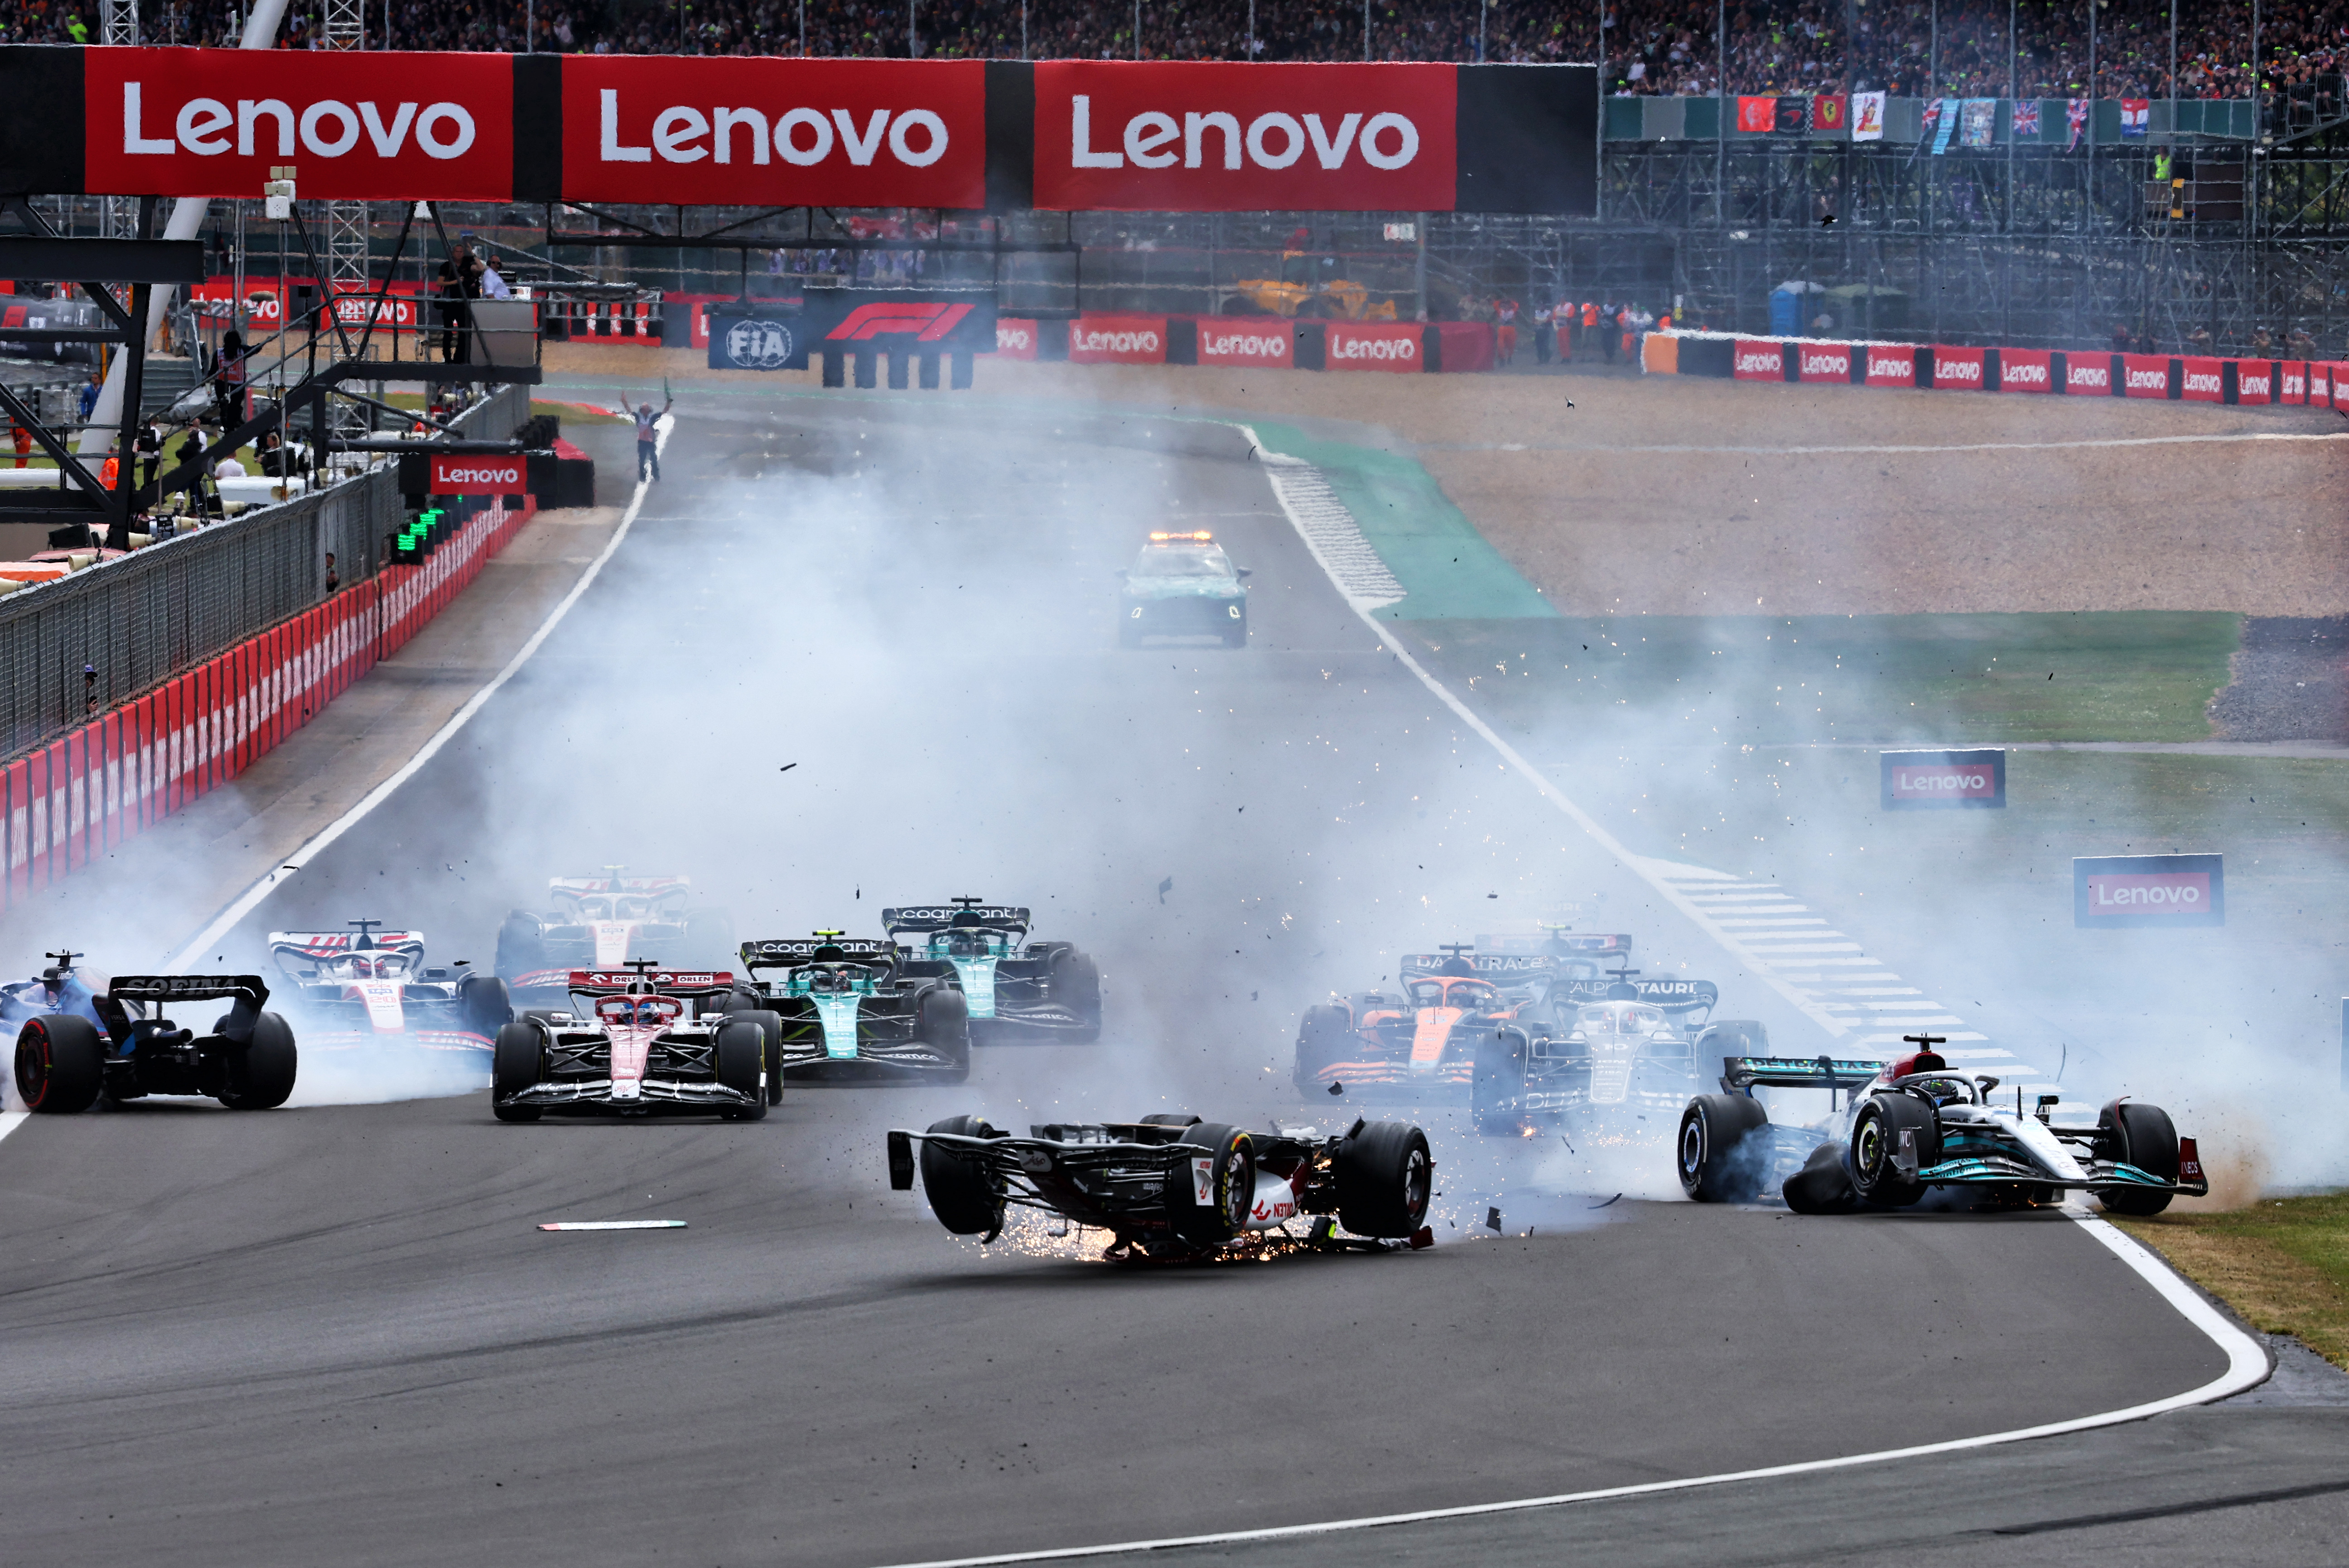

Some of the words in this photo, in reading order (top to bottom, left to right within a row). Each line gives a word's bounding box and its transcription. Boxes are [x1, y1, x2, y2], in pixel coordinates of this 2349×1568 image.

[124, 82, 476, 159] Lenovo
[600, 88, 949, 168] Lenovo
[1072, 94, 1419, 170] Lenovo
[730, 330, 786, 357] FIA
[1073, 325, 1158, 352] Lenovo
[1203, 331, 1286, 357] Lenovo
[1332, 334, 1415, 360] Lenovo
[1735, 348, 1781, 373] Lenovo
[1801, 350, 1848, 374] Lenovo
[1867, 353, 1911, 377] Lenovo
[1934, 358, 1980, 381] Lenovo
[2002, 360, 2047, 383] Lenovo
[2067, 362, 2107, 387] Lenovo
[2125, 366, 2166, 389] Lenovo
[2183, 368, 2221, 392] Lenovo
[439, 466, 518, 483] Lenovo
[1900, 772, 1985, 791] Lenovo
[2098, 883, 2199, 905] Lenovo
[762, 941, 877, 953] cognant
[1417, 955, 1543, 970] DATRACE
[123, 978, 236, 996] SOFINA
[683, 1082, 741, 1095] Accelleron
[2181, 1161, 2198, 1174] INEOS
[1273, 1202, 1293, 1217] ORLEN
